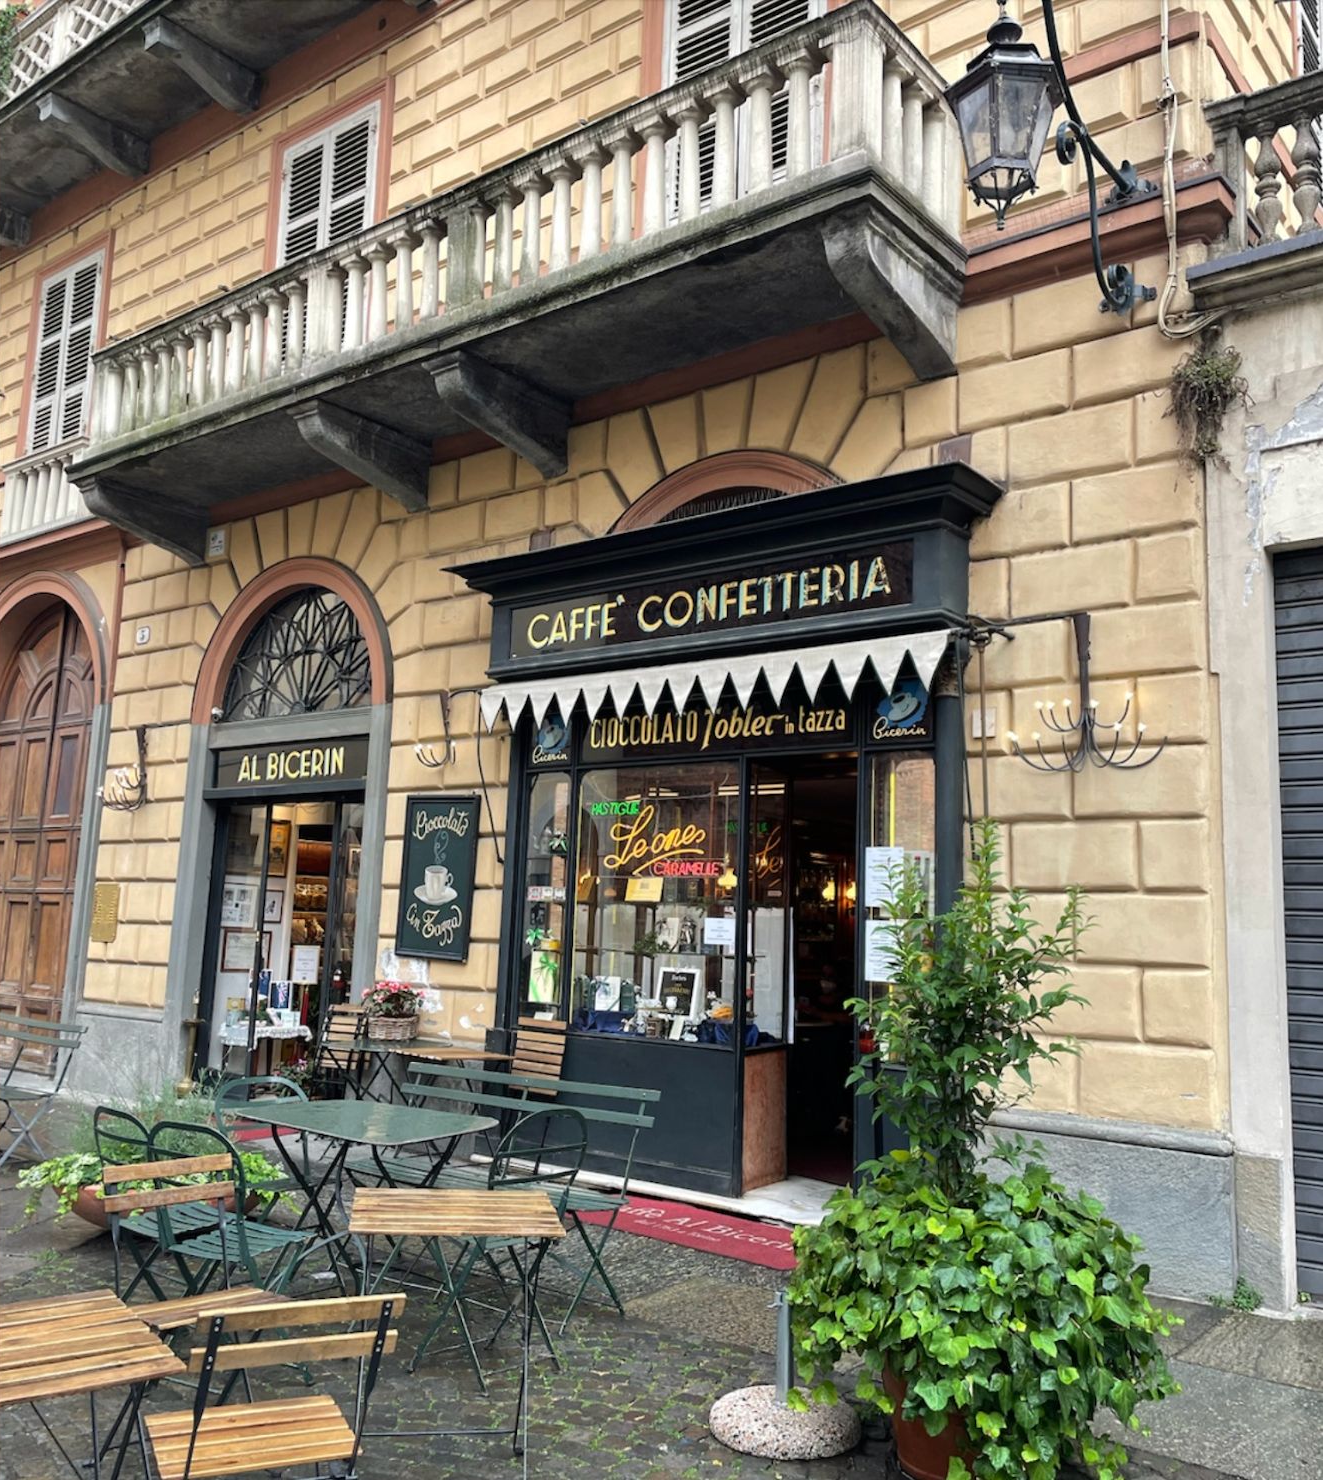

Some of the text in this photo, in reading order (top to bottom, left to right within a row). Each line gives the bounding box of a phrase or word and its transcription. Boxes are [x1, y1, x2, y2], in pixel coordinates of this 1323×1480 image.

[637, 556, 891, 633] CONFETTERIA
[590, 709, 698, 749] CIOCCOLATO
[784, 715, 795, 735] in
[799, 705, 846, 733] tazza
[873, 716, 926, 739] Bicerin
[237, 746, 345, 783] AL BICERIN
[533, 744, 568, 764] Bicerin
[662, 1217, 709, 1228] Al
